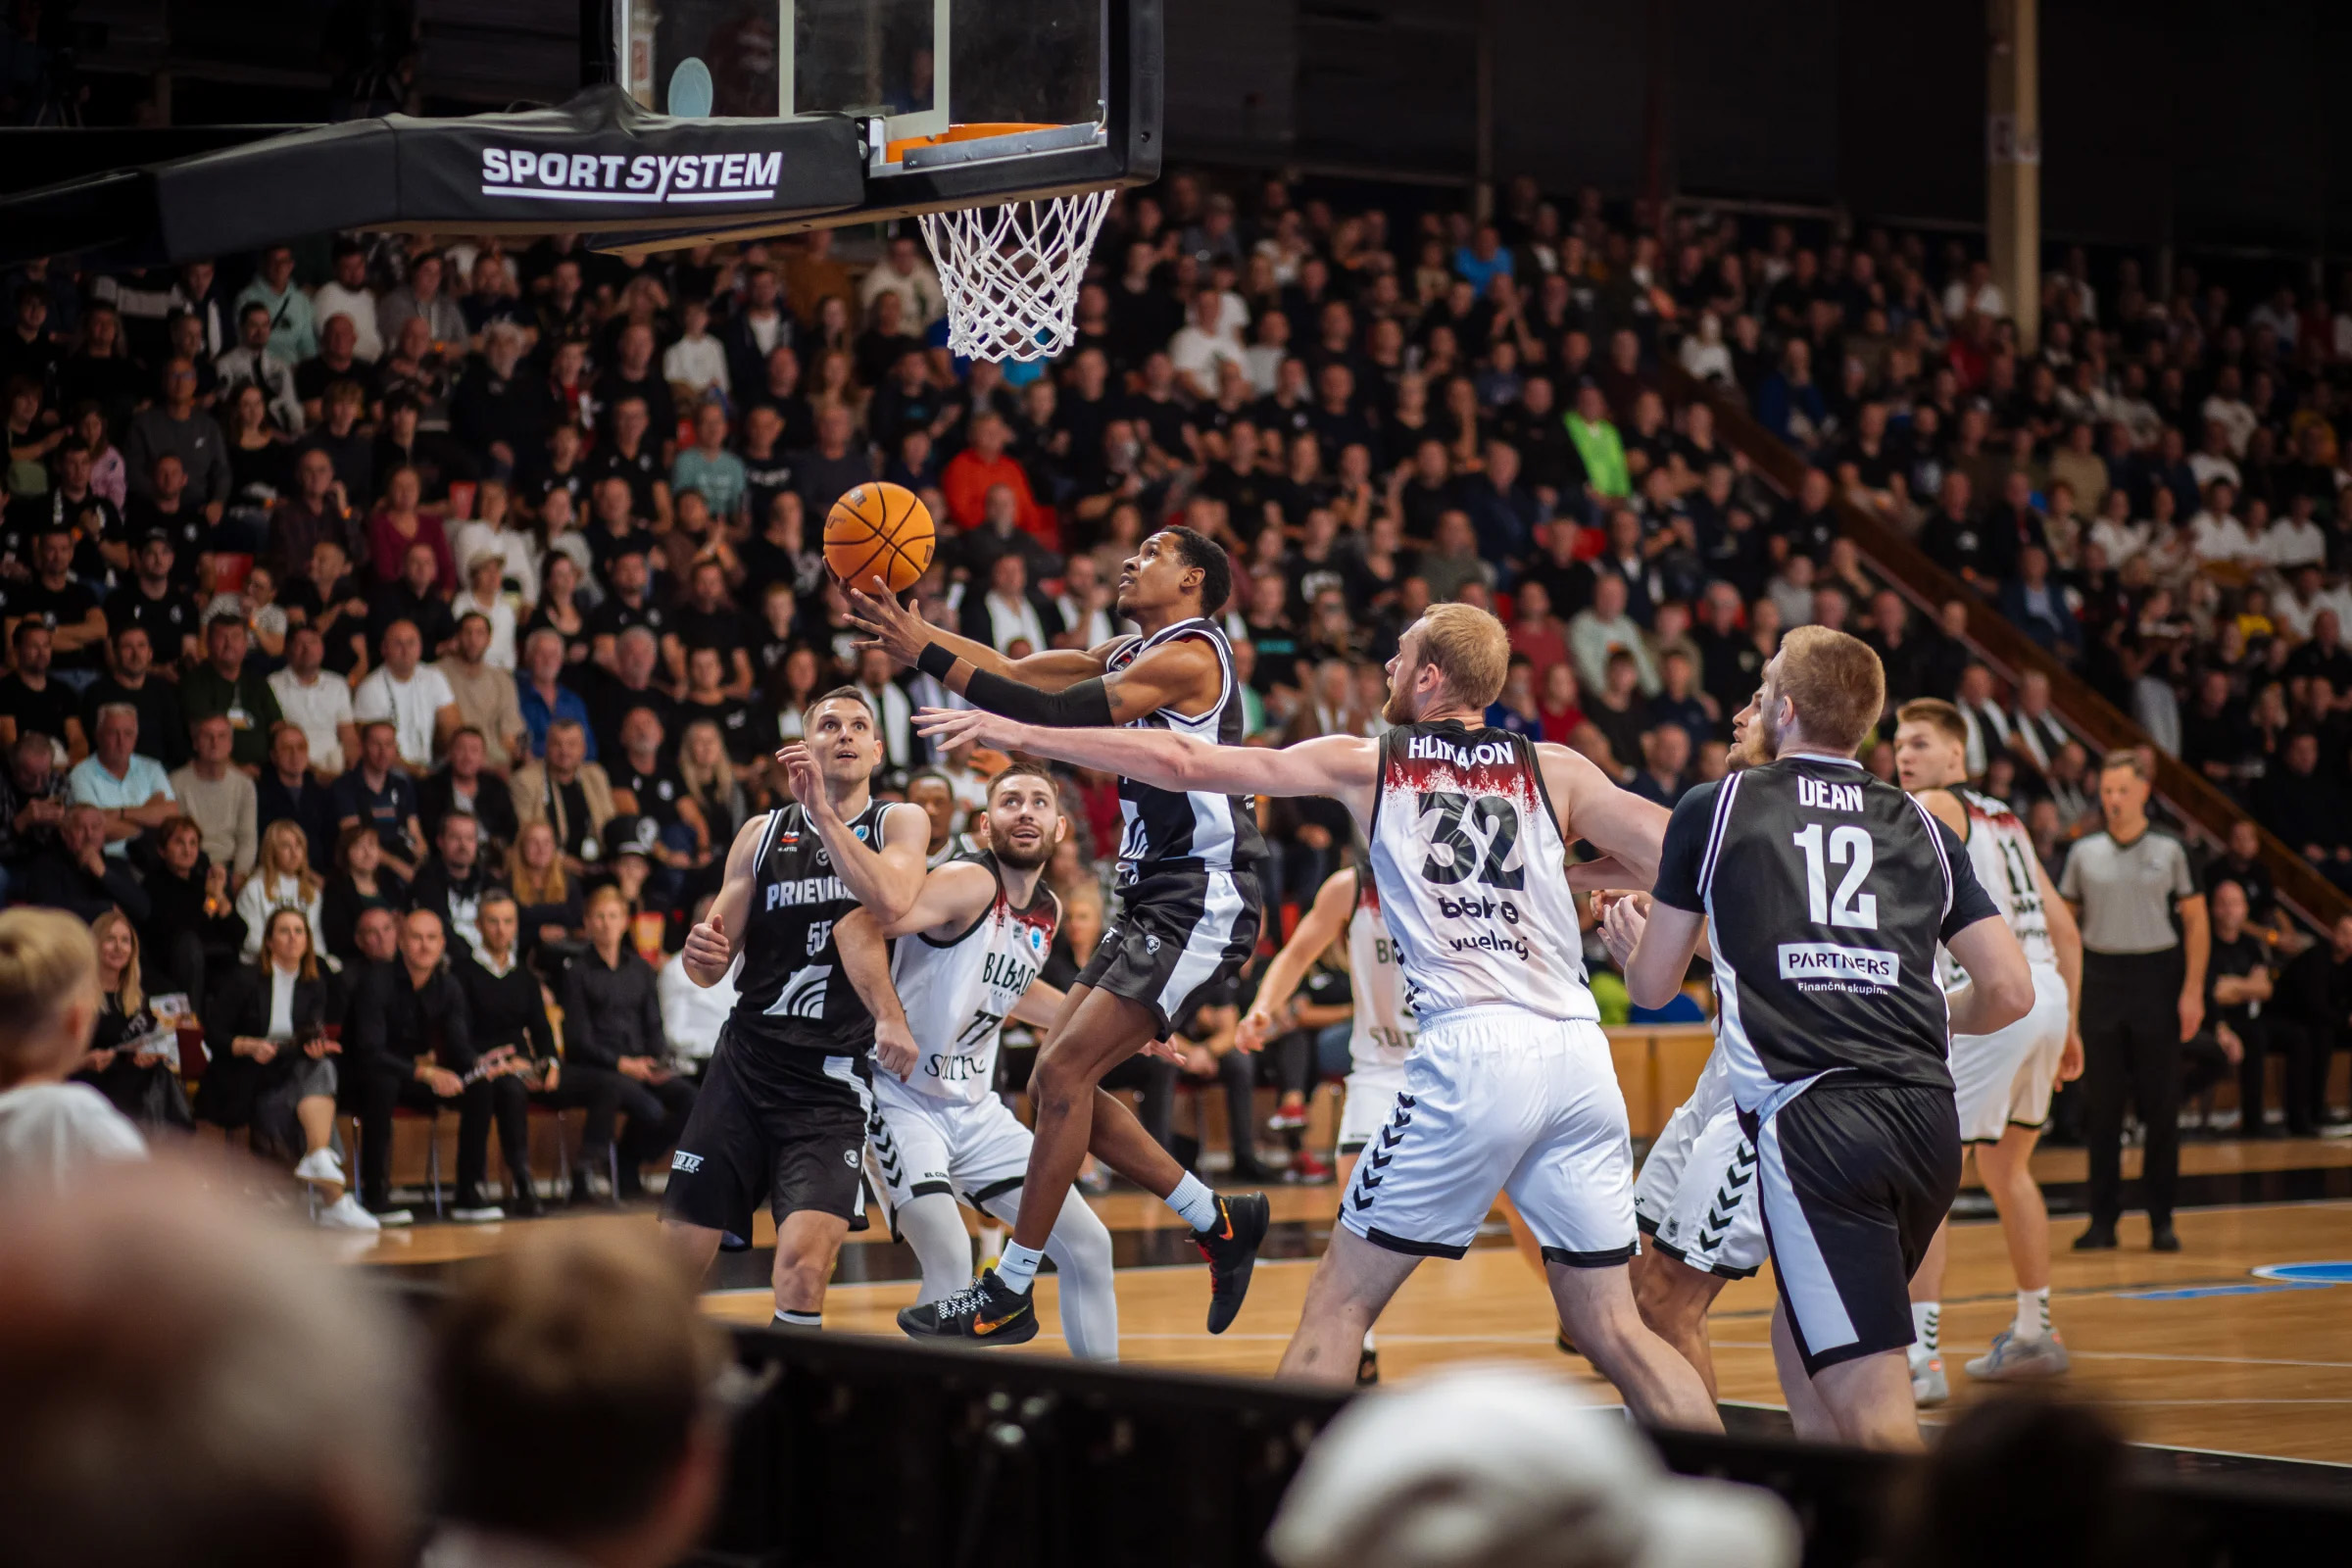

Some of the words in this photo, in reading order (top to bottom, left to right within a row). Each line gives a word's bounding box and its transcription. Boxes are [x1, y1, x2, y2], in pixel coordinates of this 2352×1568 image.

[1797, 775, 1865, 812] DEAN
[1417, 791, 1526, 892] 32
[1996, 835, 2035, 896] 11
[1792, 822, 1879, 931] 12
[1788, 952, 1890, 976] PARTNERS
[956, 1008, 1004, 1047] 77
